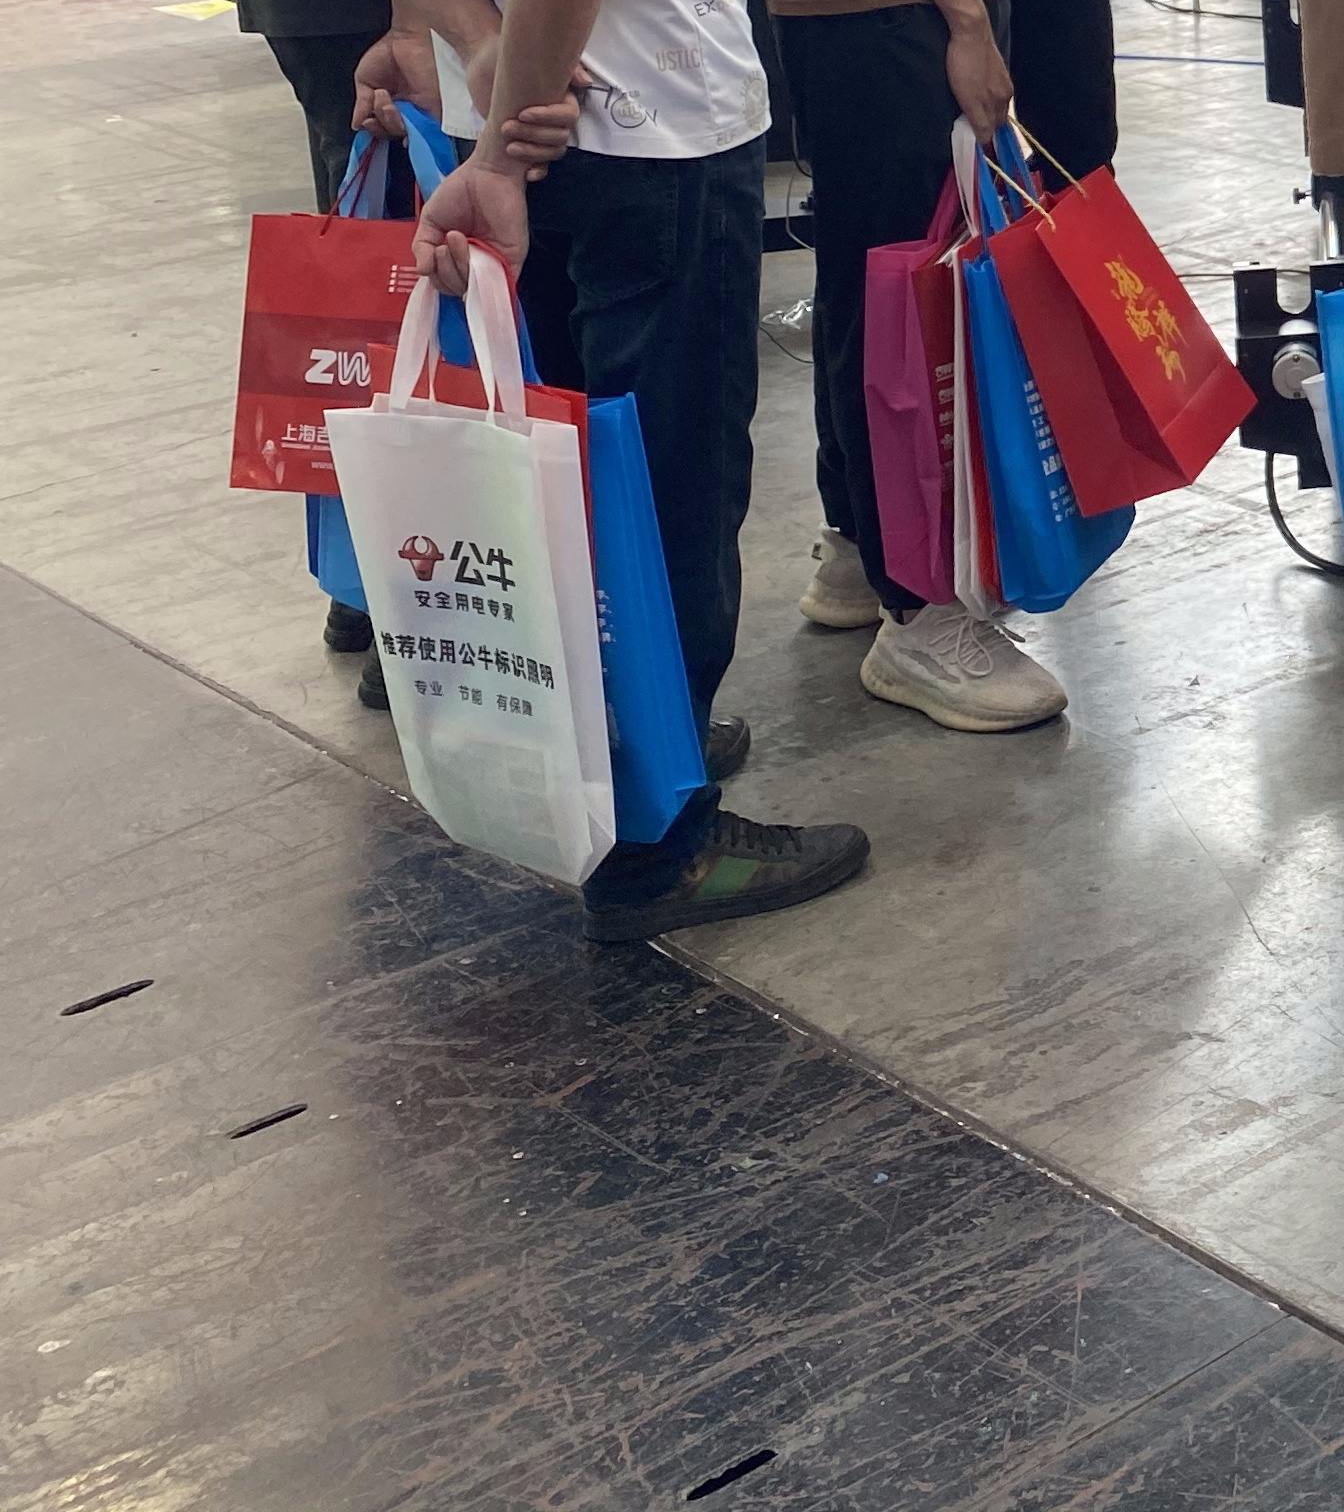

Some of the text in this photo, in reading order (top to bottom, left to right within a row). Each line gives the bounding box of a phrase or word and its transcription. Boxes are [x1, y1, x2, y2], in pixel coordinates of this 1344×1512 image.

[450, 540, 516, 592] 公牛
[414, 589, 516, 623] 安全用电专家
